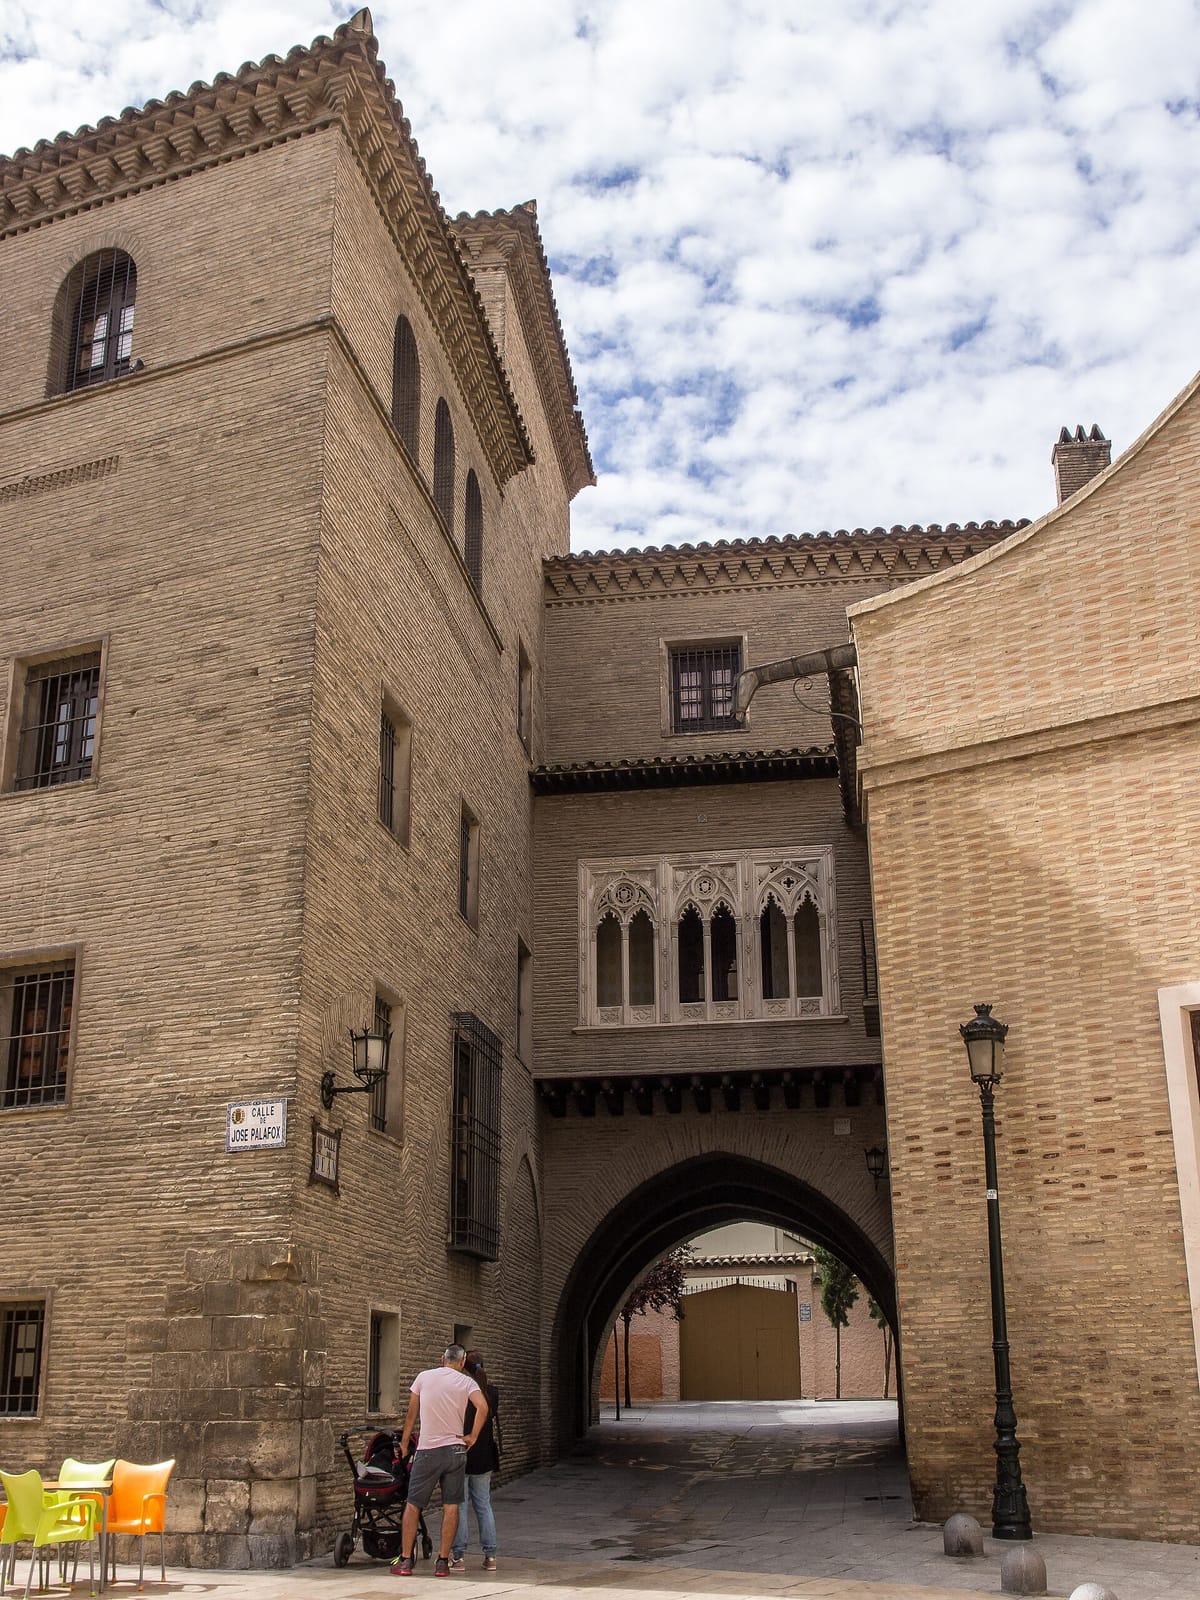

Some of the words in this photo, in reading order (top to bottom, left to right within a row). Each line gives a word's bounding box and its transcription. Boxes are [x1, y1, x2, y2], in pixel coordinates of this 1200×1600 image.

[252, 1106, 274, 1117] CALLE
[232, 1128, 248, 1142] JOSE
[251, 1126, 280, 1141] PALAFOX
